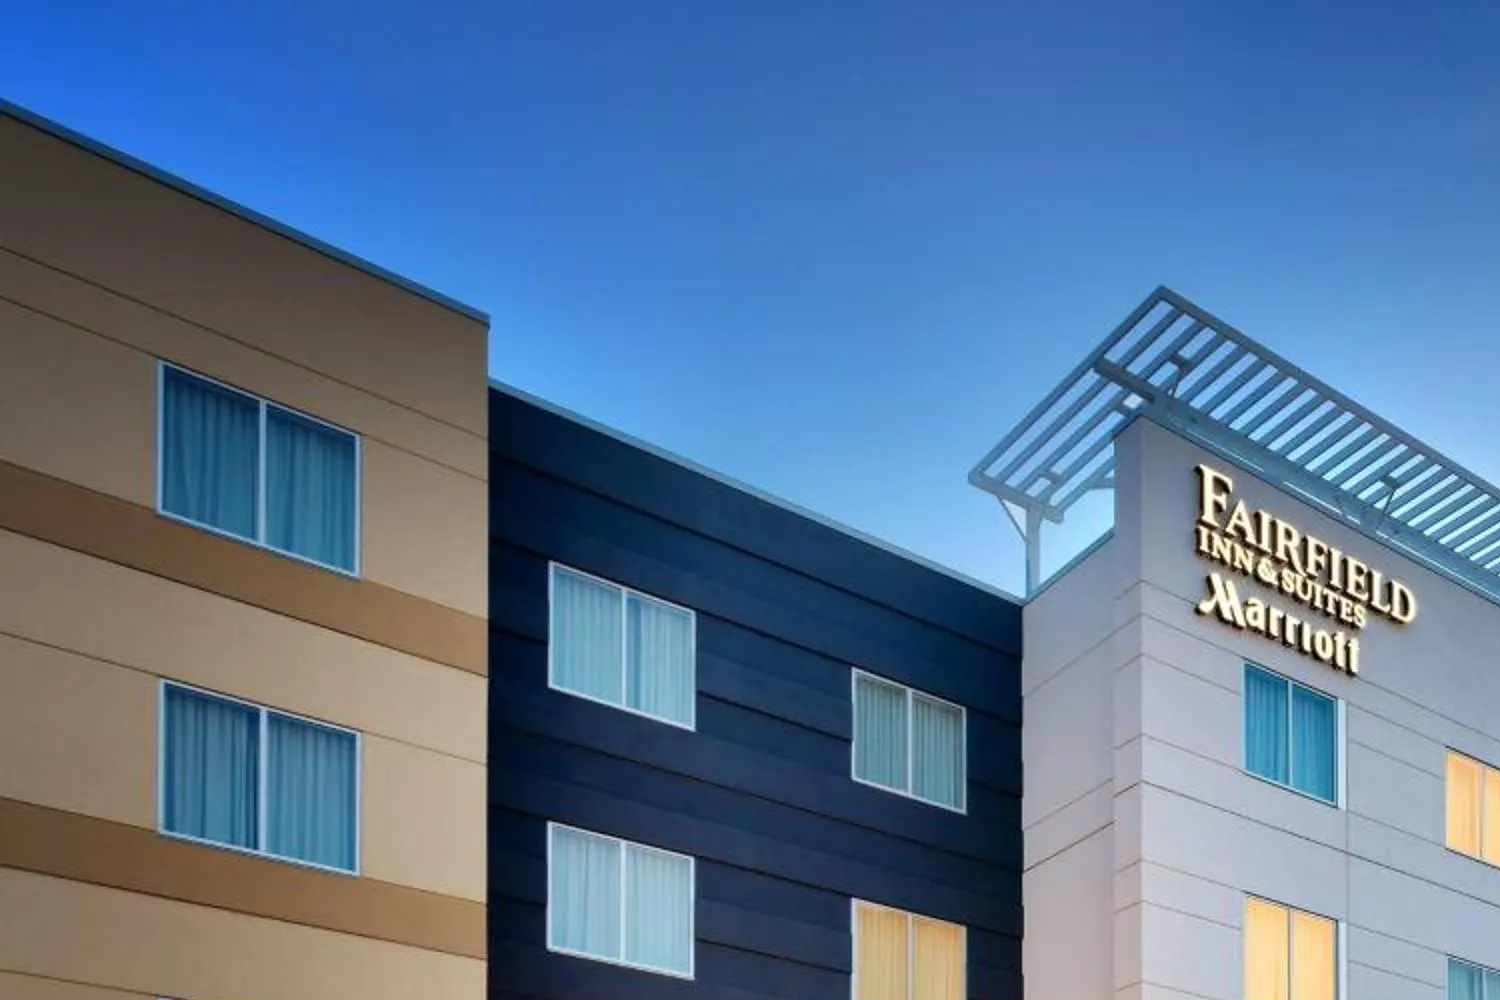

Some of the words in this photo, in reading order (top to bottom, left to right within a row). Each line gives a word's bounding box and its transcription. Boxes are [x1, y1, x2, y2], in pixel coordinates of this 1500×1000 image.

[1196, 464, 1417, 623] FAIRFIELD
[1197, 527, 1253, 573] INN
[1257, 559, 1279, 586] &
[1281, 572, 1366, 628] SUITES
[1197, 573, 1360, 674] Marriott
